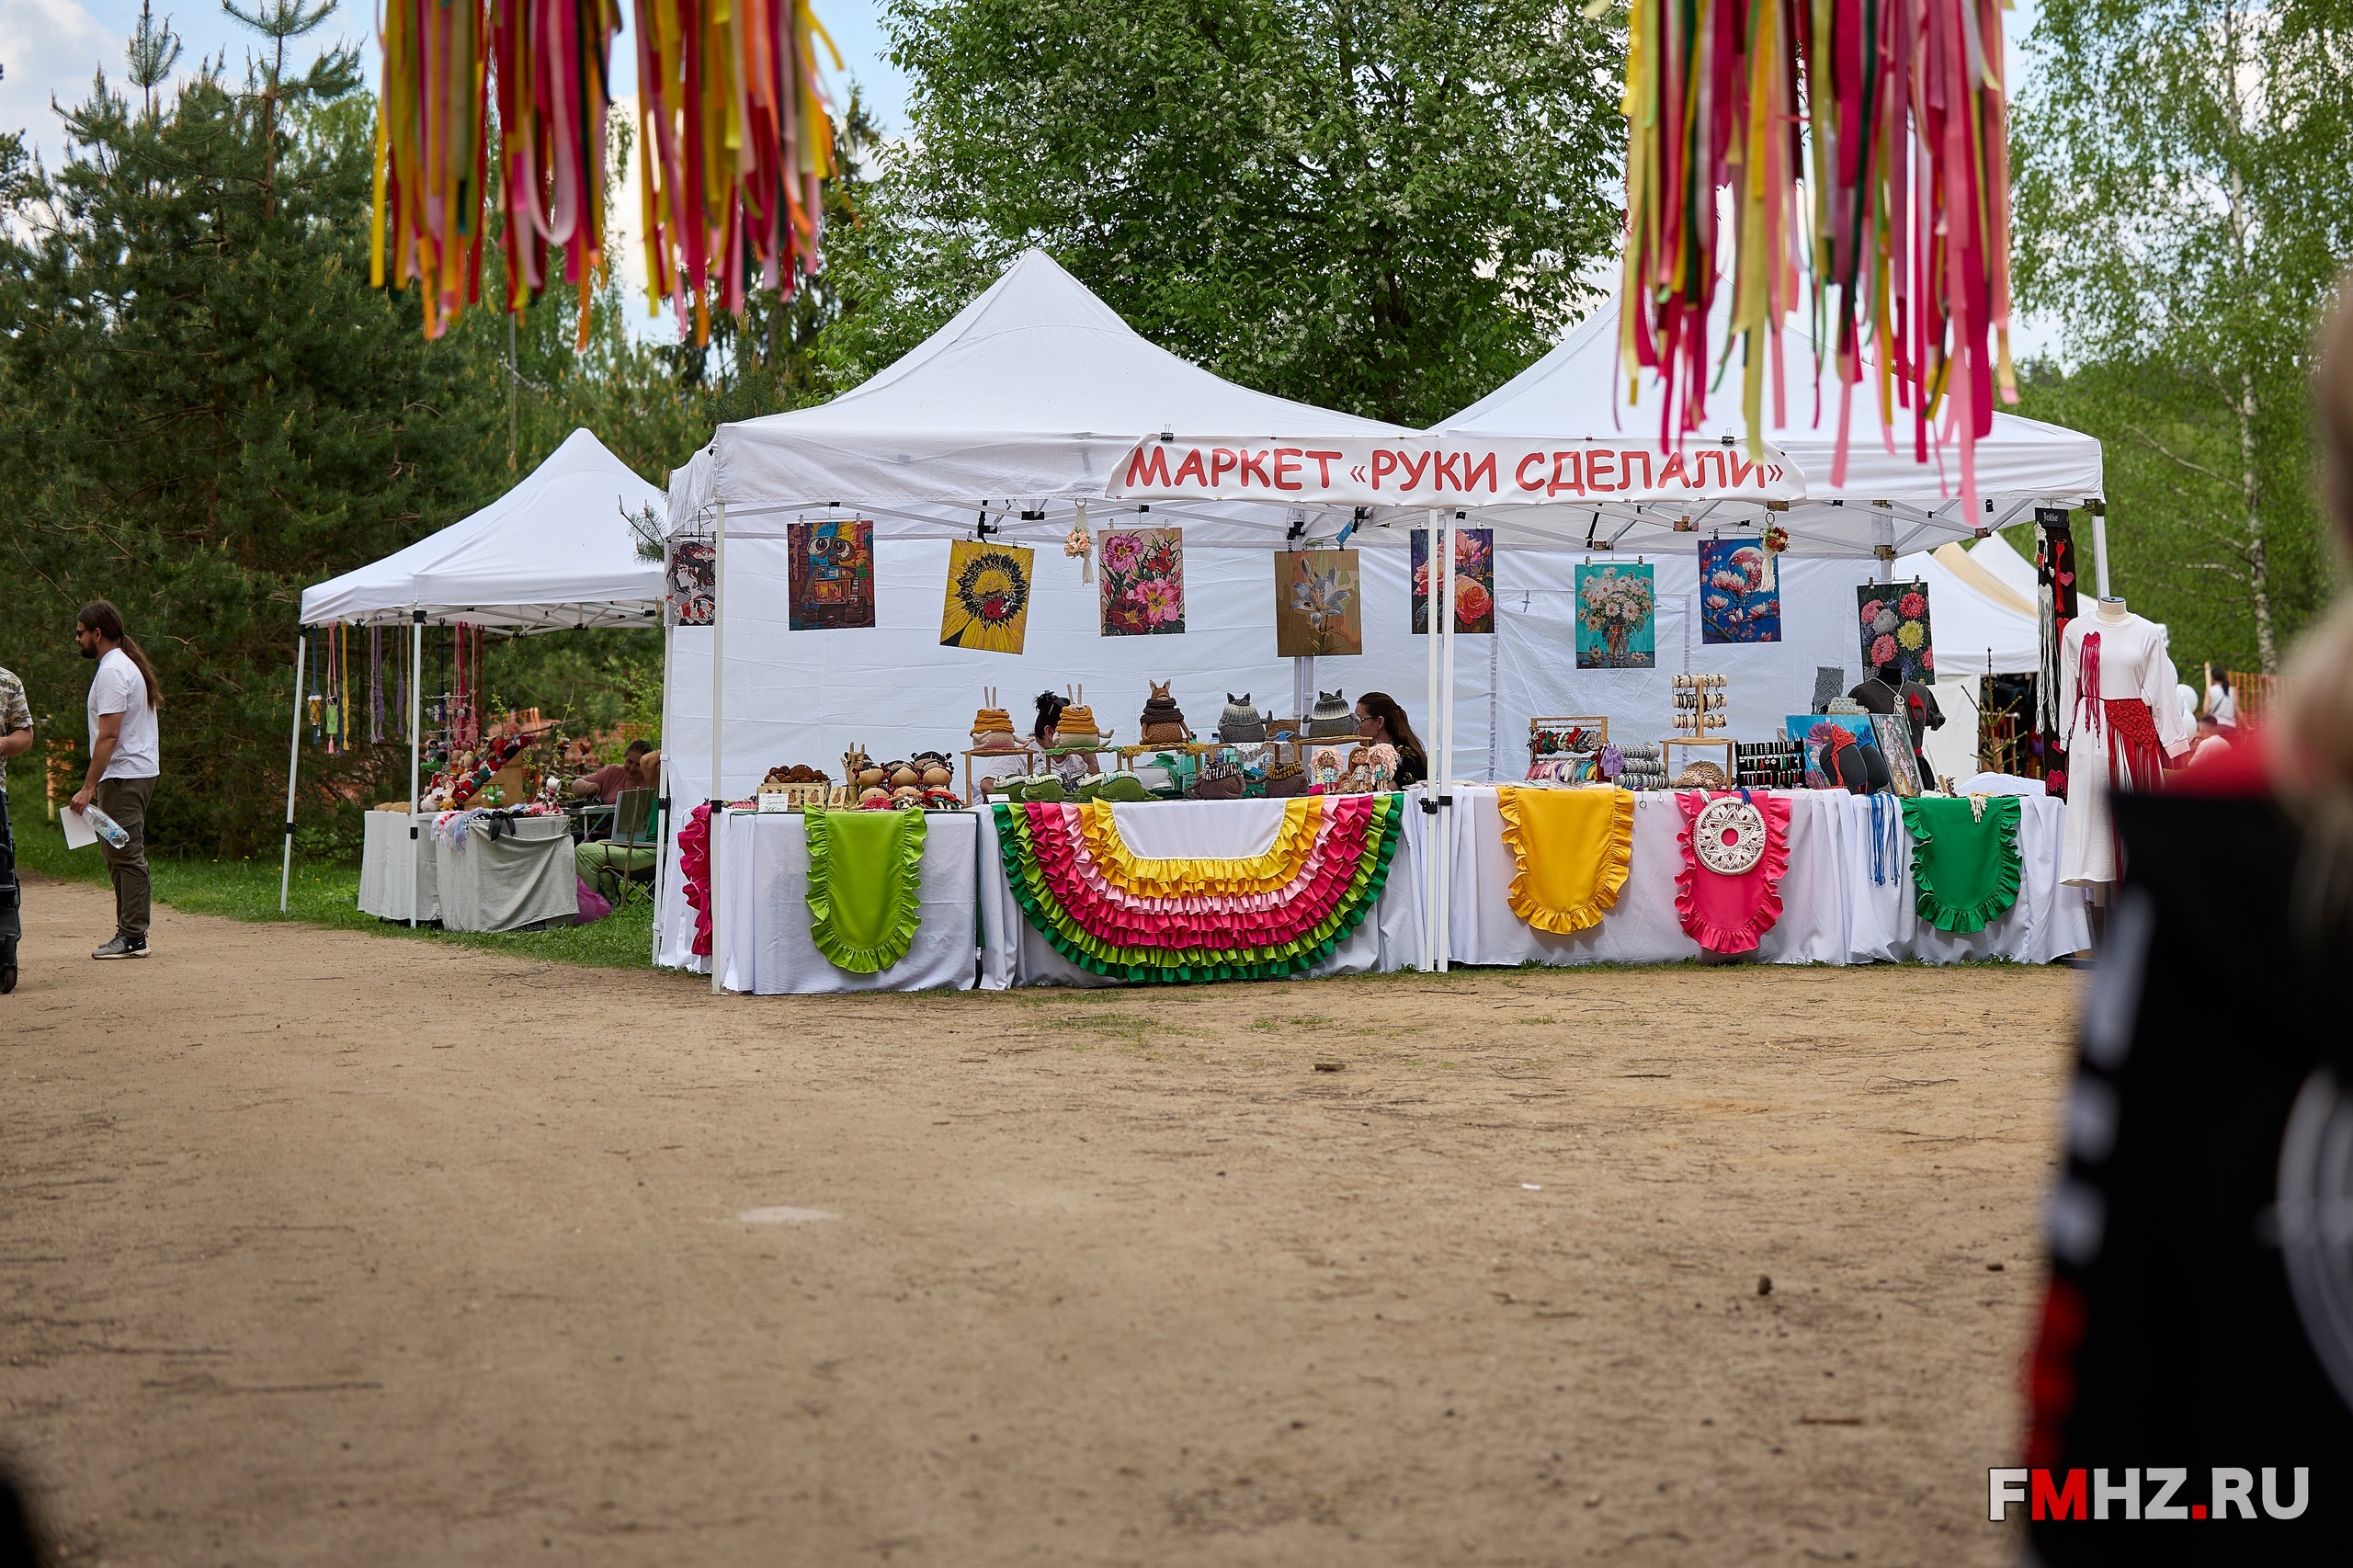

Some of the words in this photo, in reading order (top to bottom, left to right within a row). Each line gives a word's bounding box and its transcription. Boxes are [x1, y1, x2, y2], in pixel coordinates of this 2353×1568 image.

[1125, 445, 1343, 492] МАРКЕТ
[1349, 449, 1498, 493] «РУКИ
[1515, 449, 1784, 498] СДЕЛАЛИ»
[2043, 512, 2059, 523] Jolie
